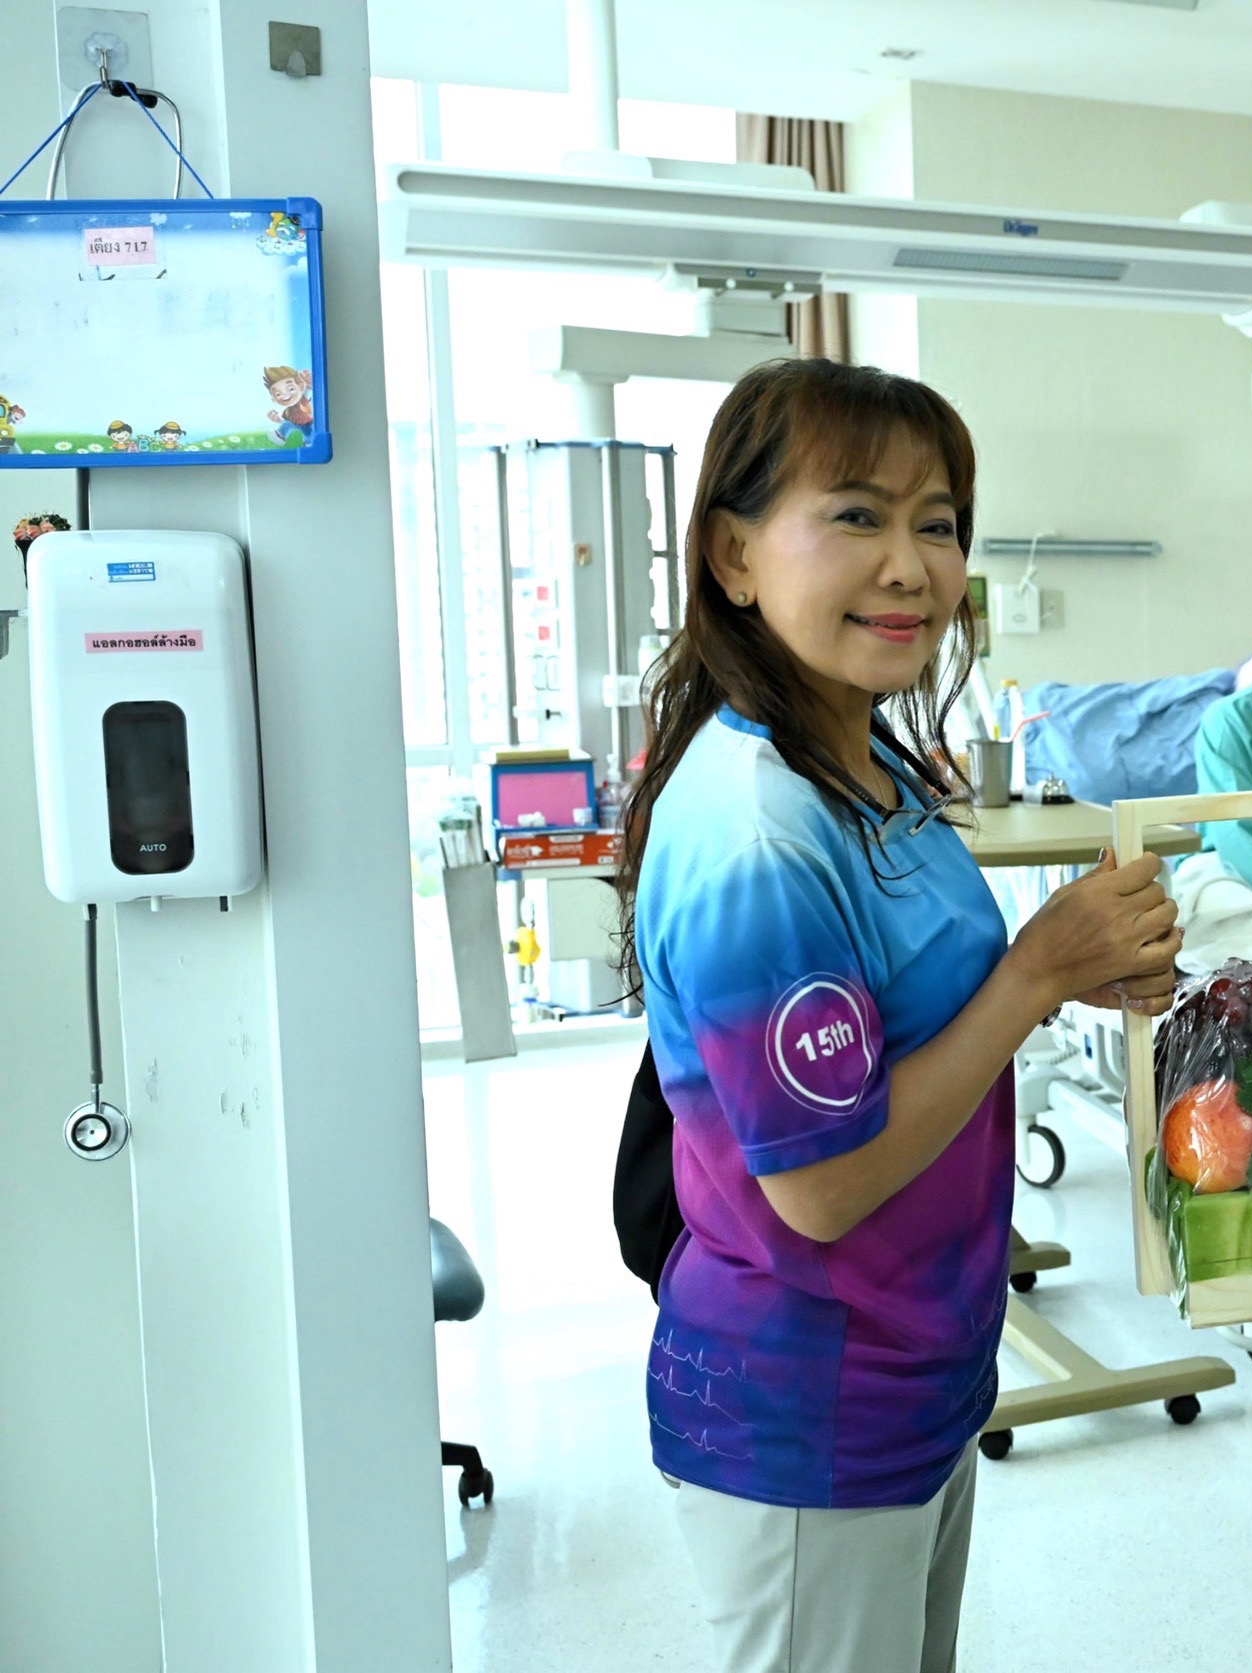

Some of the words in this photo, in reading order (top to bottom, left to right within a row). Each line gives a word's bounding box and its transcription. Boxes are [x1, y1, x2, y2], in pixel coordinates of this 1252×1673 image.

[90, 237, 121, 254] เตียง
[124, 241, 148, 253] 717
[92, 634, 197, 649] แอลกอฮอล์ล้างมือ
[140, 843, 167, 852] AUTO
[795, 1020, 855, 1062] 15th
